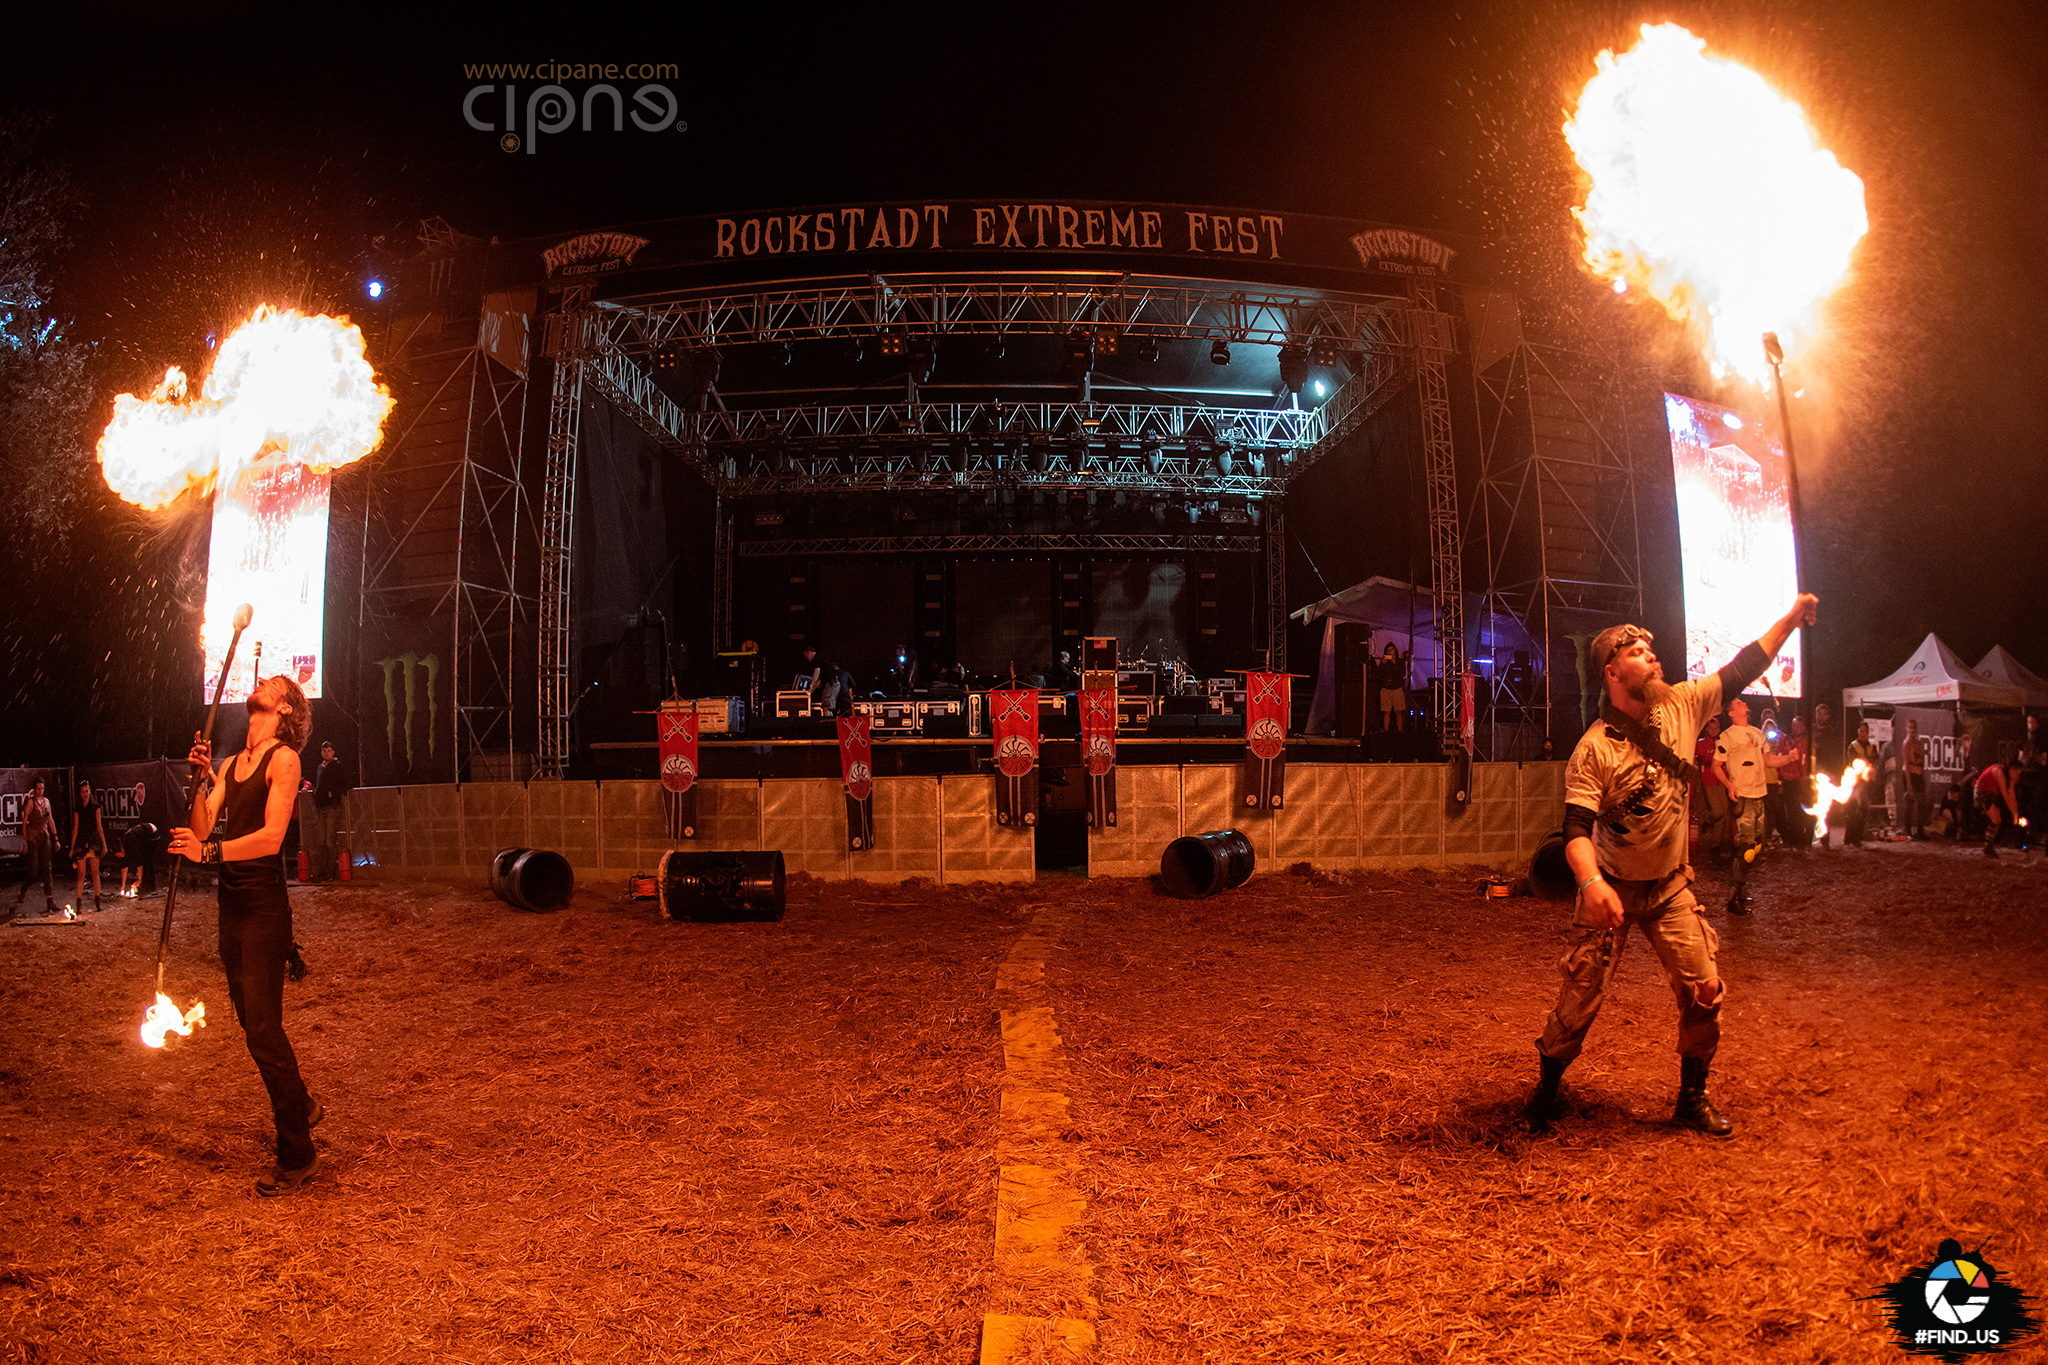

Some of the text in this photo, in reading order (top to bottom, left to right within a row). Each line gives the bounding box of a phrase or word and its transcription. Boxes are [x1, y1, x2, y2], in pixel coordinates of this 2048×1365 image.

[541, 232, 651, 279] ROCKSTADT
[713, 205, 1284, 260] ROCKSTADT EXTREME FEST
[1349, 230, 1456, 275] ROCKSTADT
